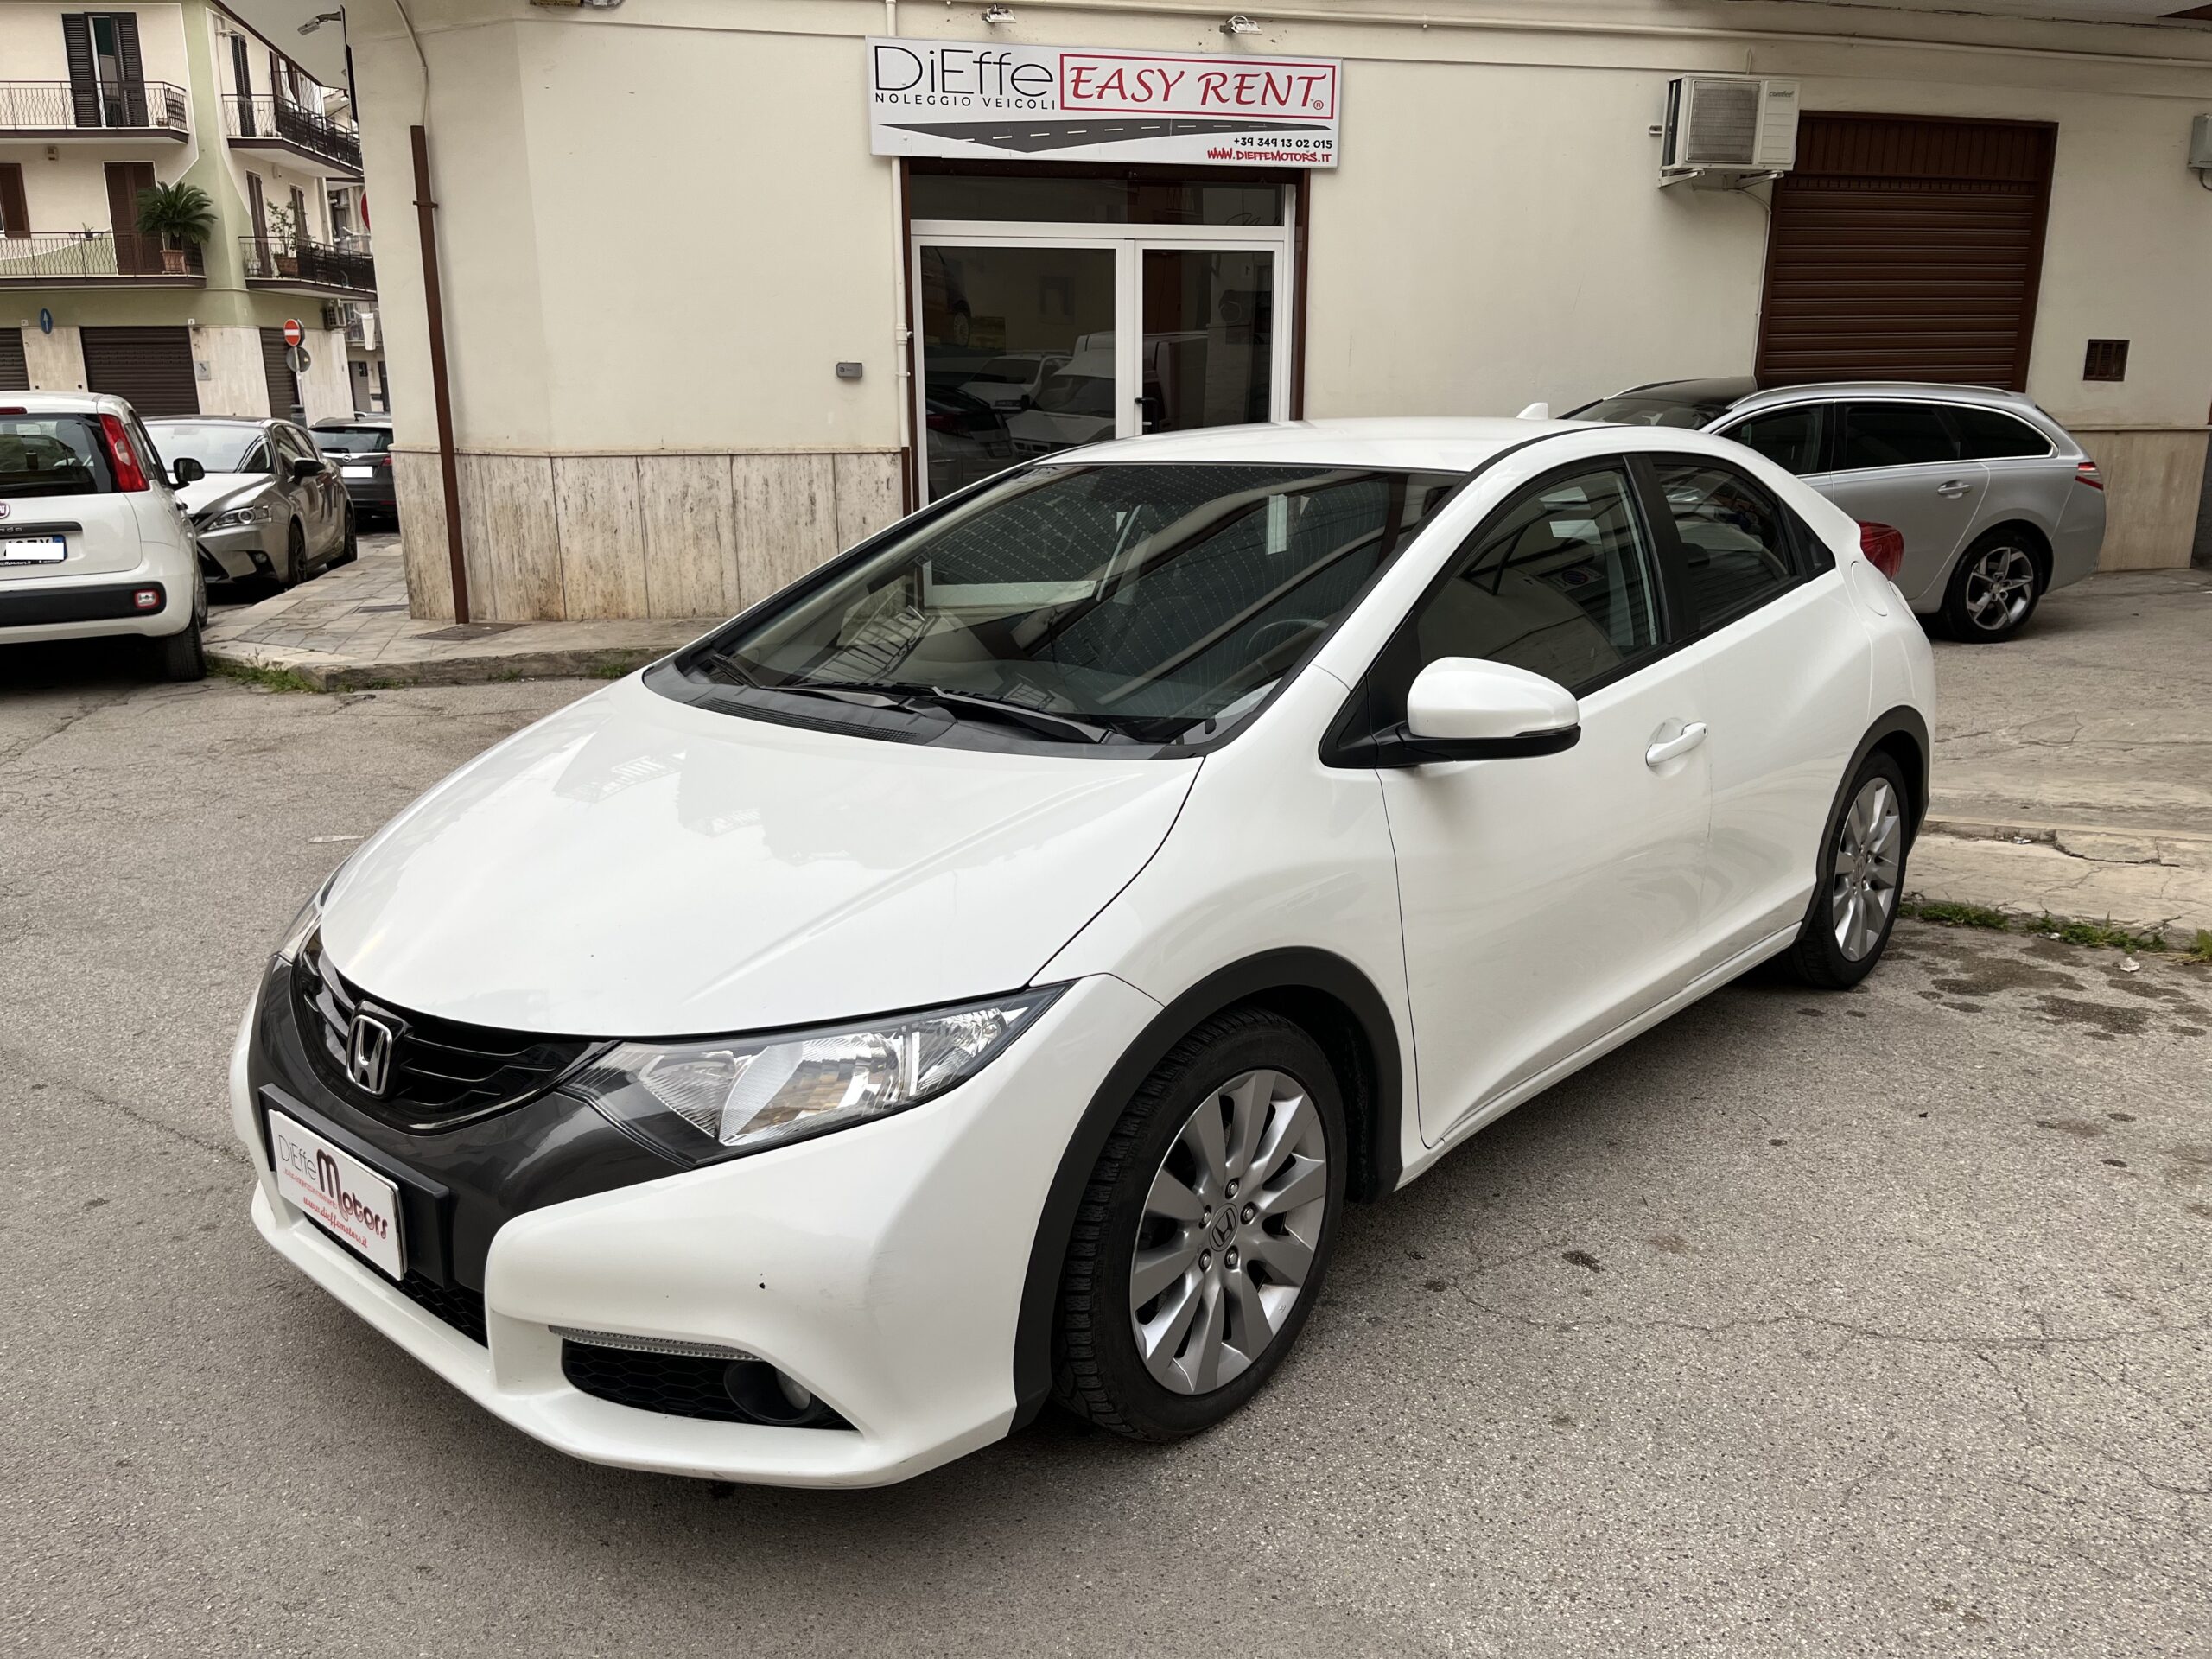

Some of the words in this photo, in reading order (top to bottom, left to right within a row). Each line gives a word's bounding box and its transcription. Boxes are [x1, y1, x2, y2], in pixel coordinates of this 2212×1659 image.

[874, 46, 1053, 97] DiEffe
[1070, 67, 1185, 102] EASY
[875, 92, 971, 106] NOLEGGIO
[982, 97, 1055, 110] VEICOLI
[1207, 147, 1332, 162] WWW.DIEFFEMOTORS.IT
[1234, 137, 1253, 147] +39
[1257, 137, 1277, 147] 349
[1281, 138, 1292, 148] 13
[1295, 139, 1310, 148] 02
[1313, 140, 1332, 149] 015
[278, 1135, 317, 1181] DiEffe
[316, 1148, 388, 1239] Motors
